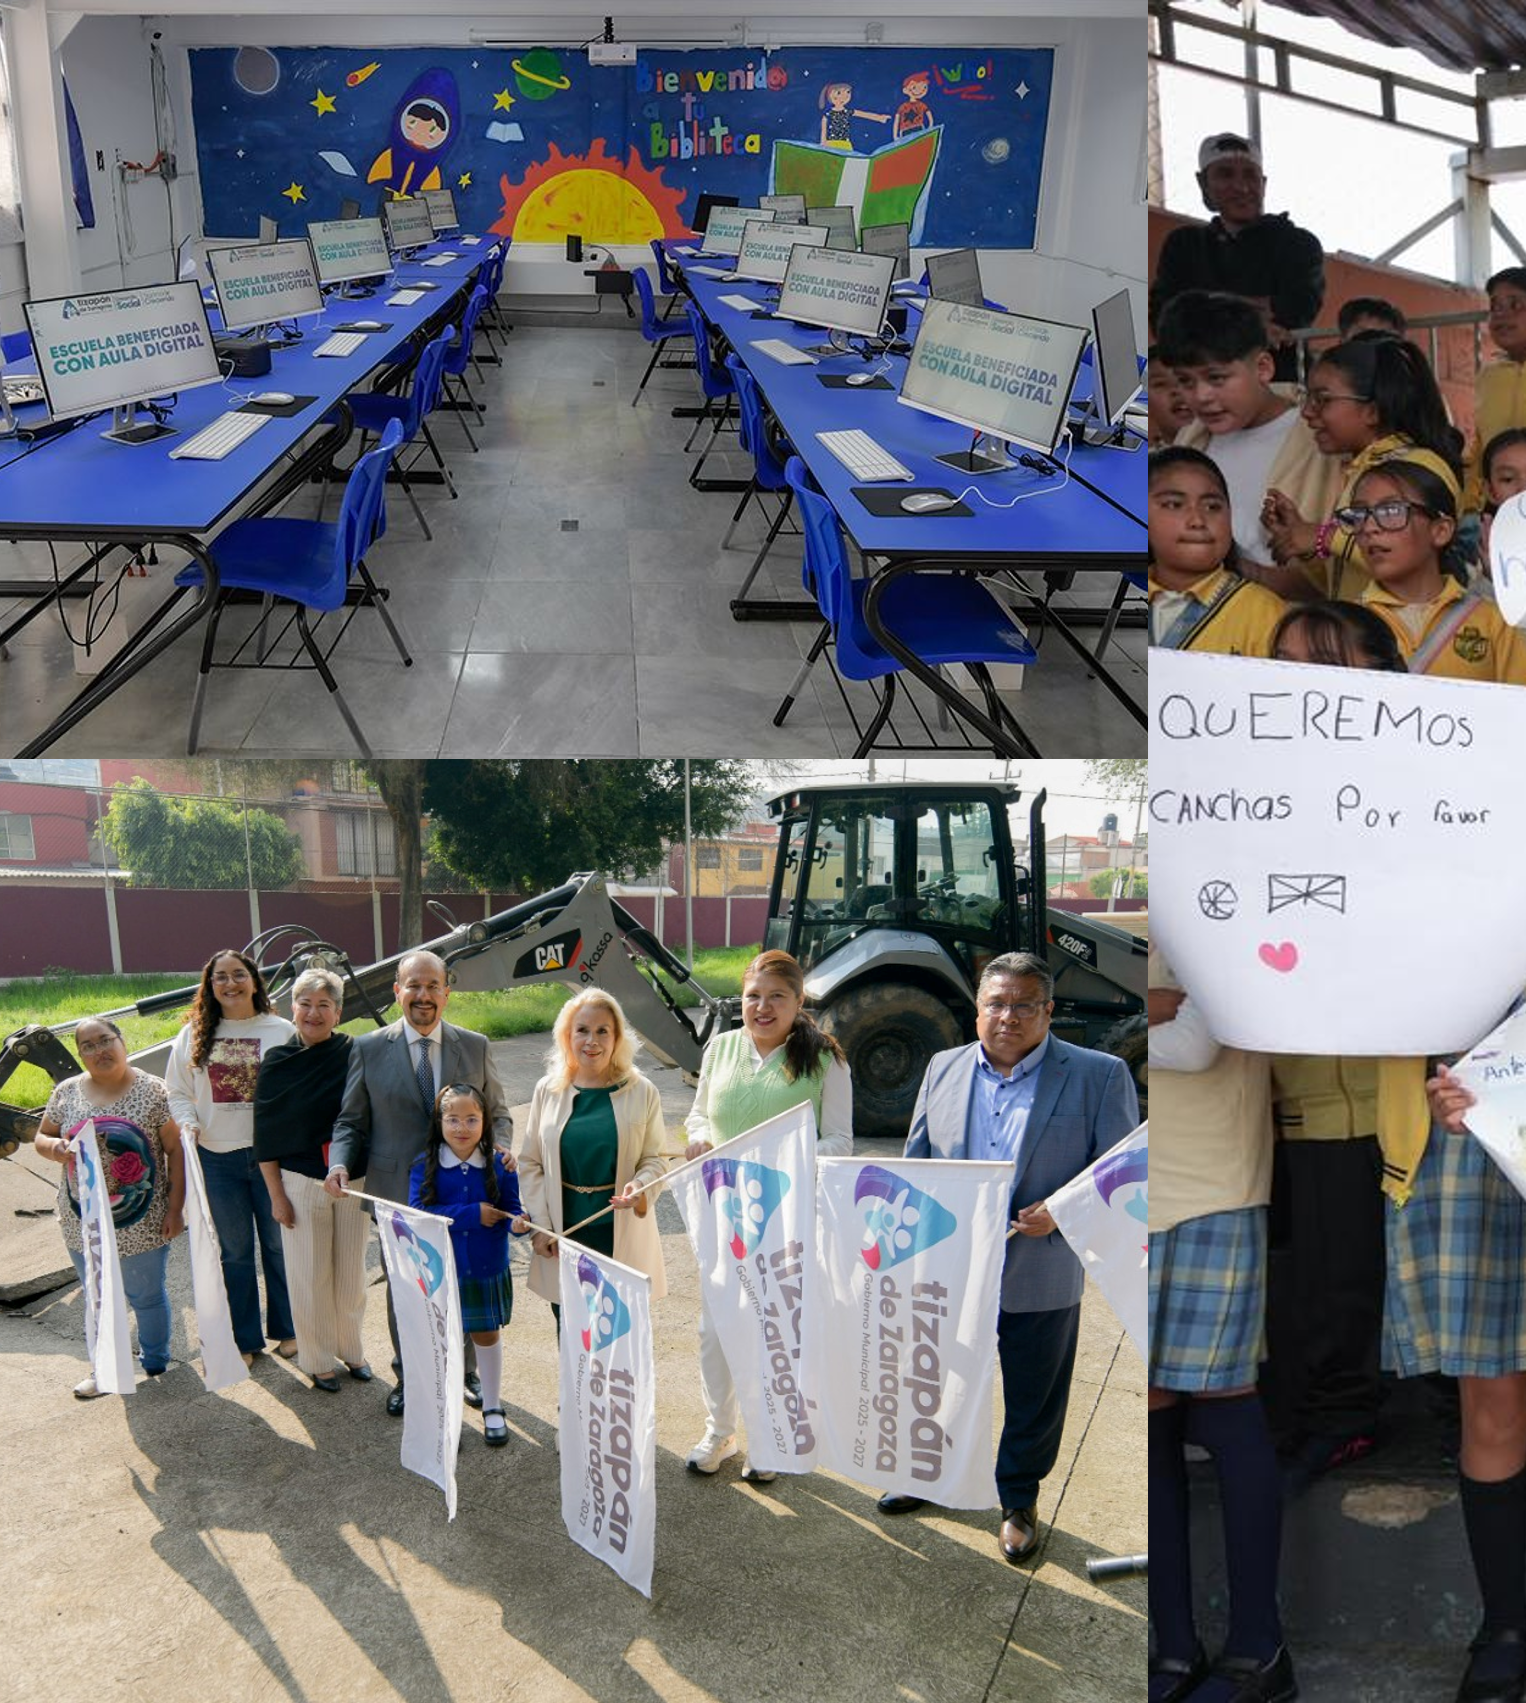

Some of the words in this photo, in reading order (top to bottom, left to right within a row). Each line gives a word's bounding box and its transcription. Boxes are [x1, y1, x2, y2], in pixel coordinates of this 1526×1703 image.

[681, 92, 705, 122] tu
[650, 116, 761, 160] Biblioteca
[317, 242, 345, 253] ESCUELA
[319, 251, 337, 262] CON
[338, 250, 357, 259] AULA
[744, 250, 762, 259] CON
[762, 251, 783, 261] AULA
[223, 277, 260, 290] ESCUELA
[260, 268, 311, 284] BENEFICIADA
[225, 288, 251, 301] CON
[251, 283, 277, 296] AULA
[279, 278, 313, 292] DIGITAL
[788, 282, 811, 294] CON
[811, 286, 836, 300] AULA
[837, 291, 878, 307] DIGITAL
[791, 273, 825, 286] ESCUELA
[826, 278, 880, 296] BENEFICIADA
[50, 336, 116, 359] ESCUELA
[116, 321, 200, 347] BENEFICIADA
[53, 355, 96, 376] CON
[99, 345, 143, 368] AULA
[145, 333, 204, 358] DIGITAL
[918, 354, 950, 375] CON
[950, 365, 987, 387] AULA
[989, 376, 1054, 406] DIGITAL
[922, 340, 972, 364] ESCUELA
[973, 353, 1058, 388] BENEFICIADA
[1158, 690, 1473, 748] QUEREMOS
[534, 943, 565, 971] CAT
[735, 1265, 762, 1316] Gobierno
[861, 1272, 873, 1330] Gobierno
[879, 1275, 902, 1319] de
[589, 1358, 607, 1398] de
[858, 1332, 872, 1393] Municipal
[903, 1280, 953, 1483] tizapán
[856, 1397, 870, 1428] 2025
[772, 1425, 788, 1455] 2027
[853, 1438, 867, 1469] 2027
[604, 1367, 636, 1555] tizapán
[580, 1500, 591, 1527] 2027
